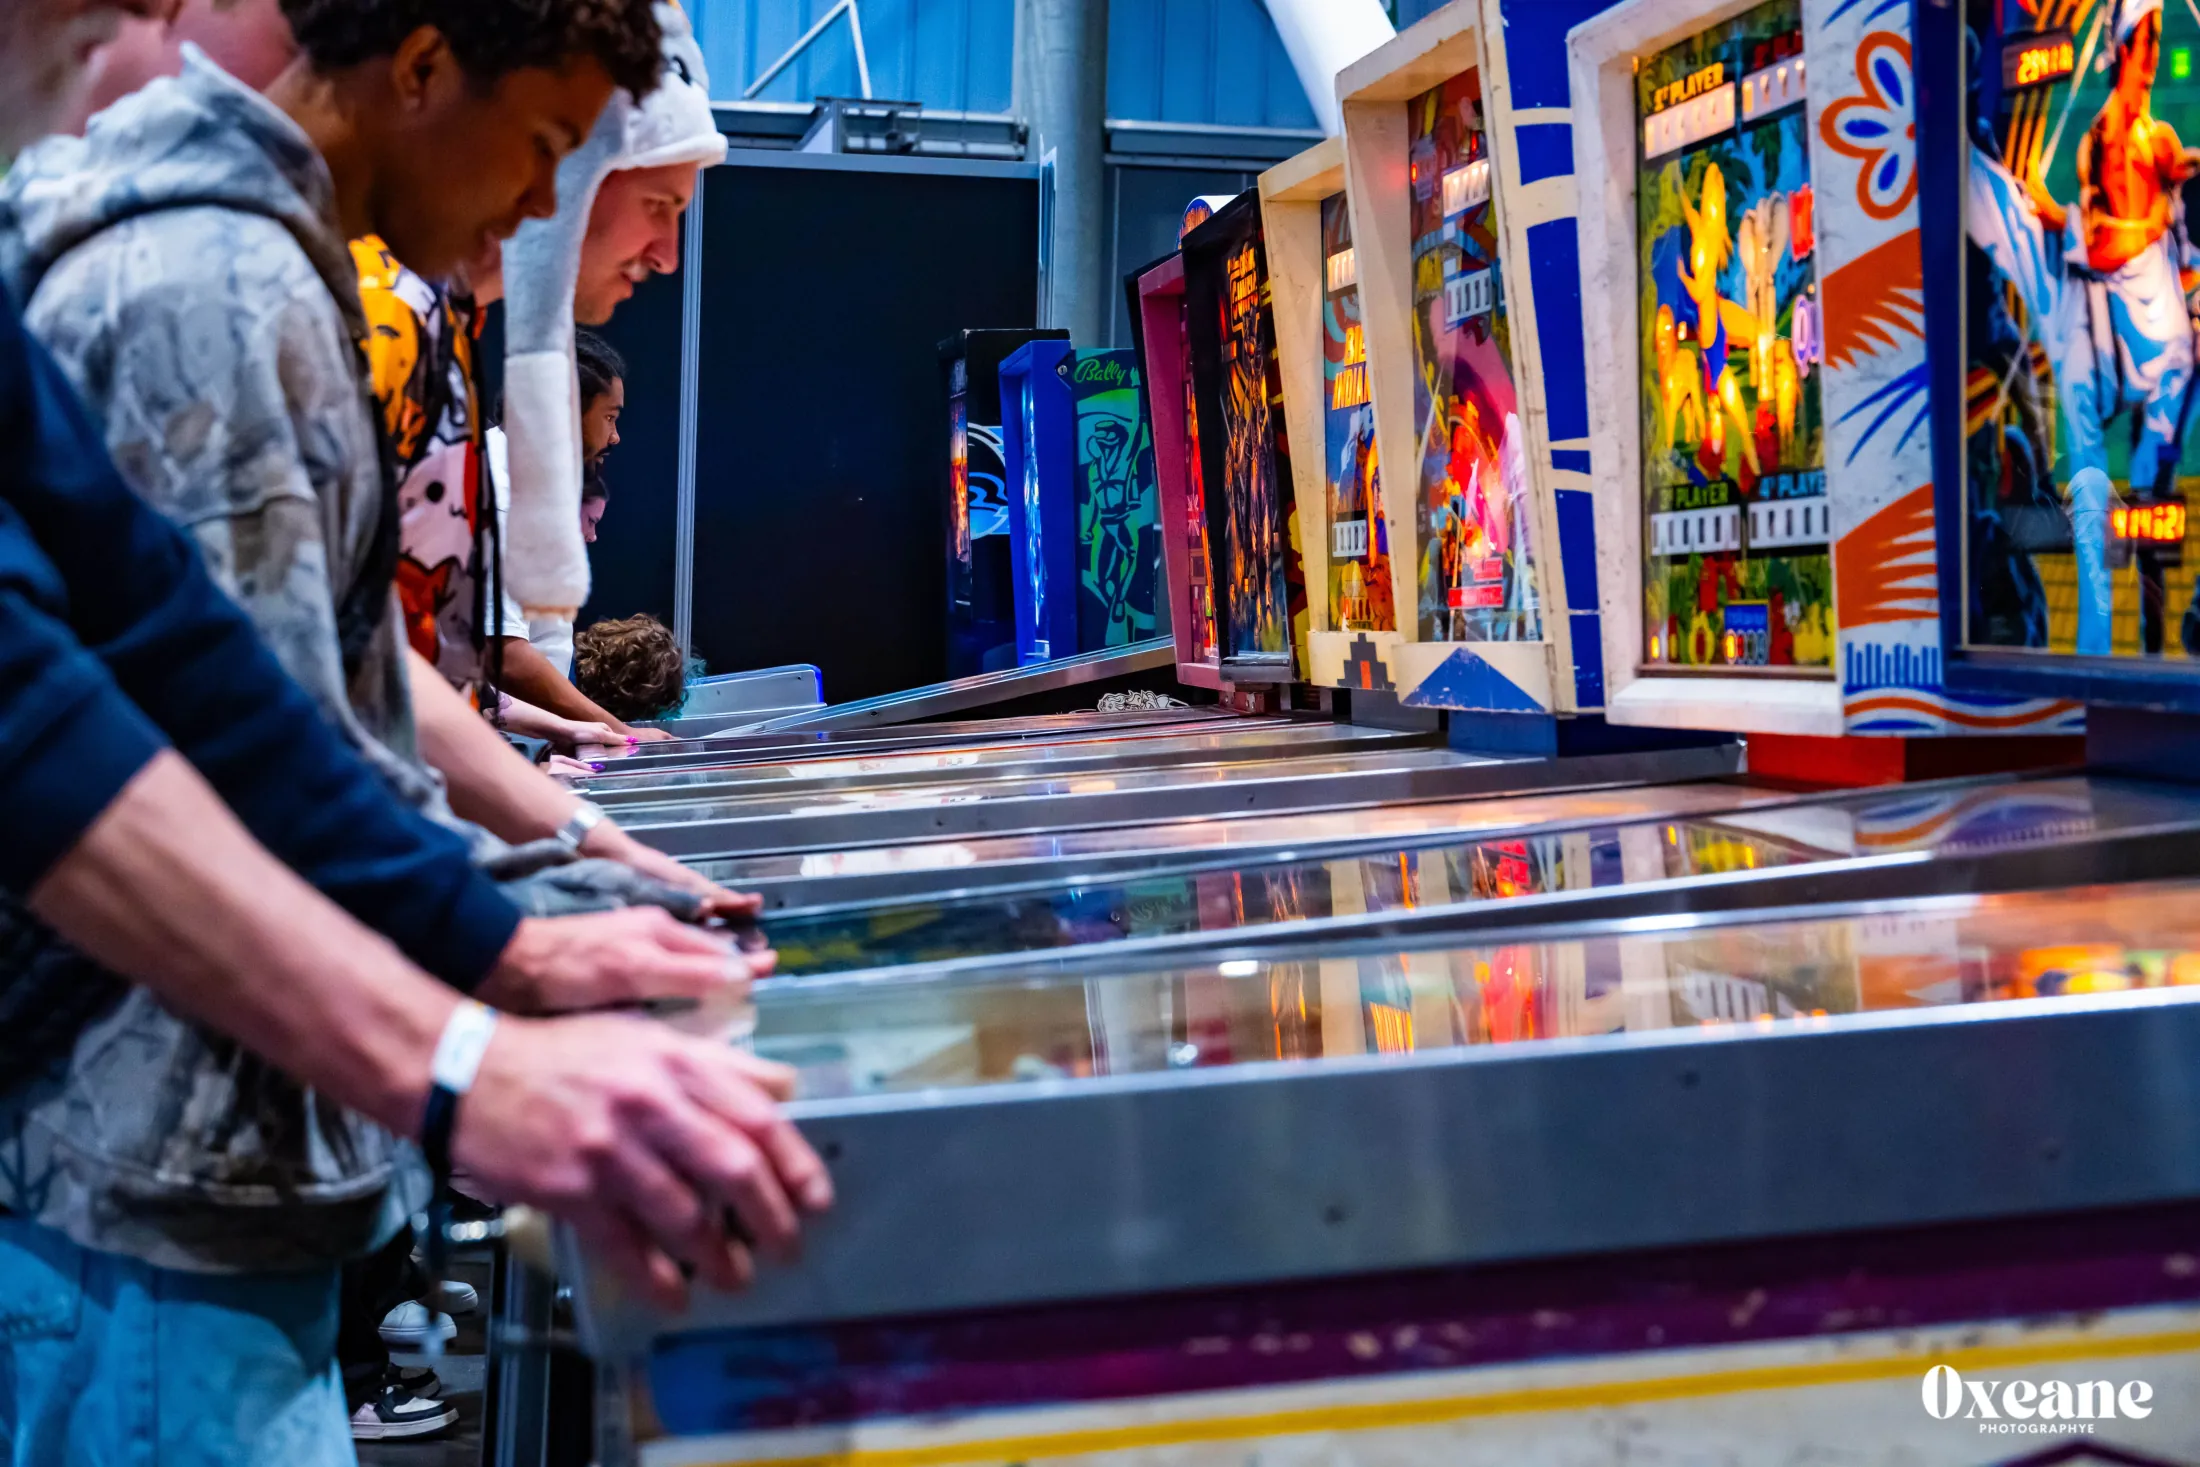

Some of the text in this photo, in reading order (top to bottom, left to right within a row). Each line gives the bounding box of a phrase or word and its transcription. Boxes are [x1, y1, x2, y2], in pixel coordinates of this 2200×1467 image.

[1670, 62, 1724, 105] PLAYER
[1074, 358, 1127, 386] Bally
[1675, 482, 1729, 508] PLAYER
[1777, 469, 1827, 497] PLAYE
